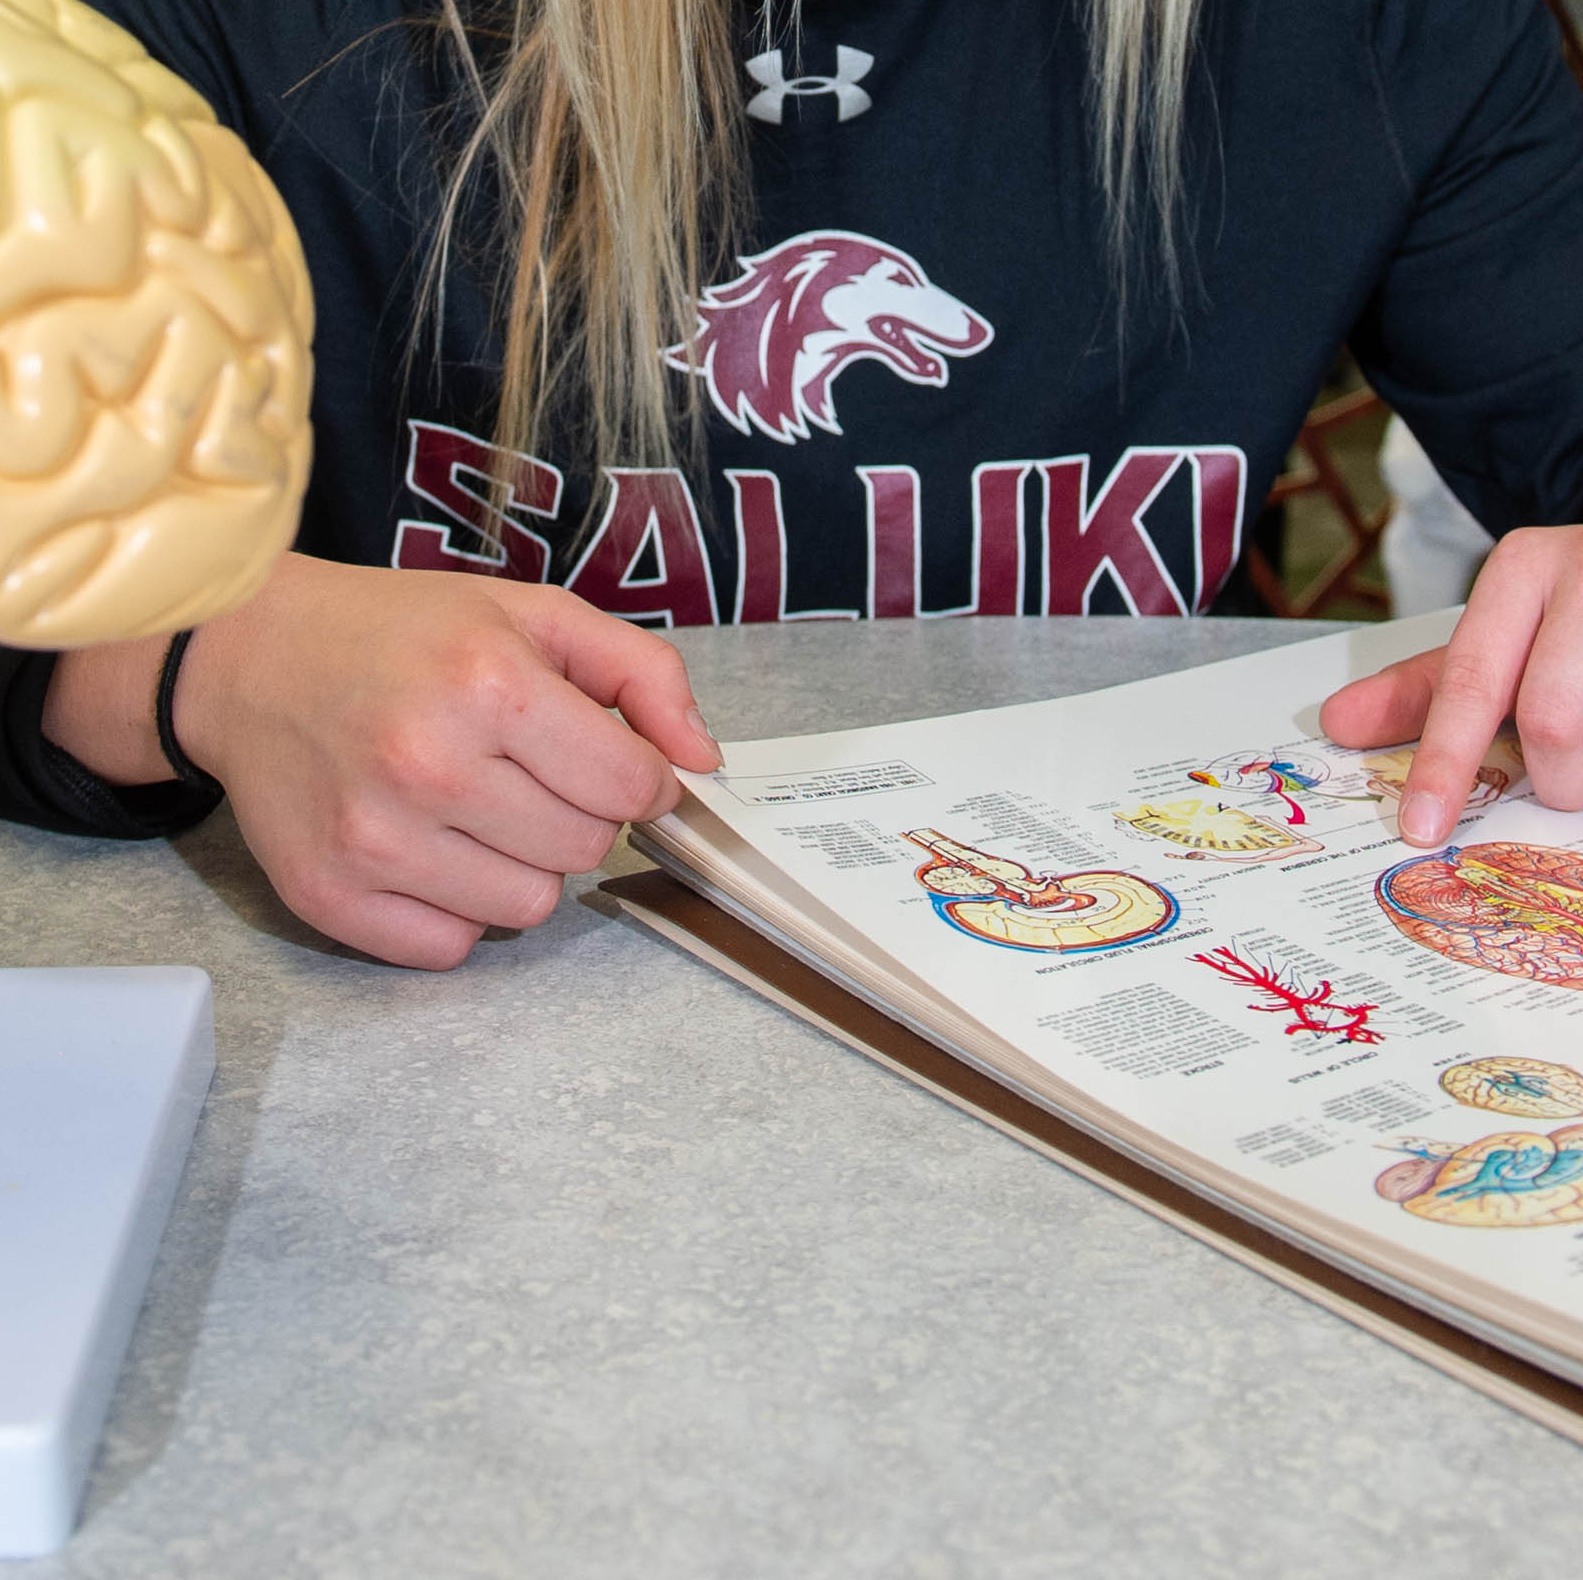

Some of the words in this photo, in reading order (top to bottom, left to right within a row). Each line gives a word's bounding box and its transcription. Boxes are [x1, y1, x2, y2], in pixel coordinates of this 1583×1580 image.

[1279, 857, 1328, 872] CEREBRUM
[1133, 927, 1213, 950] CEREBROSPINAL
[1103, 948, 1134, 958] FLUID
[1035, 956, 1103, 974] CIRCULATION
[1340, 1052, 1378, 1066] CIRCLE
[1181, 1061, 1224, 1076] STROKE
[1288, 1070, 1324, 1084] WILLIS
